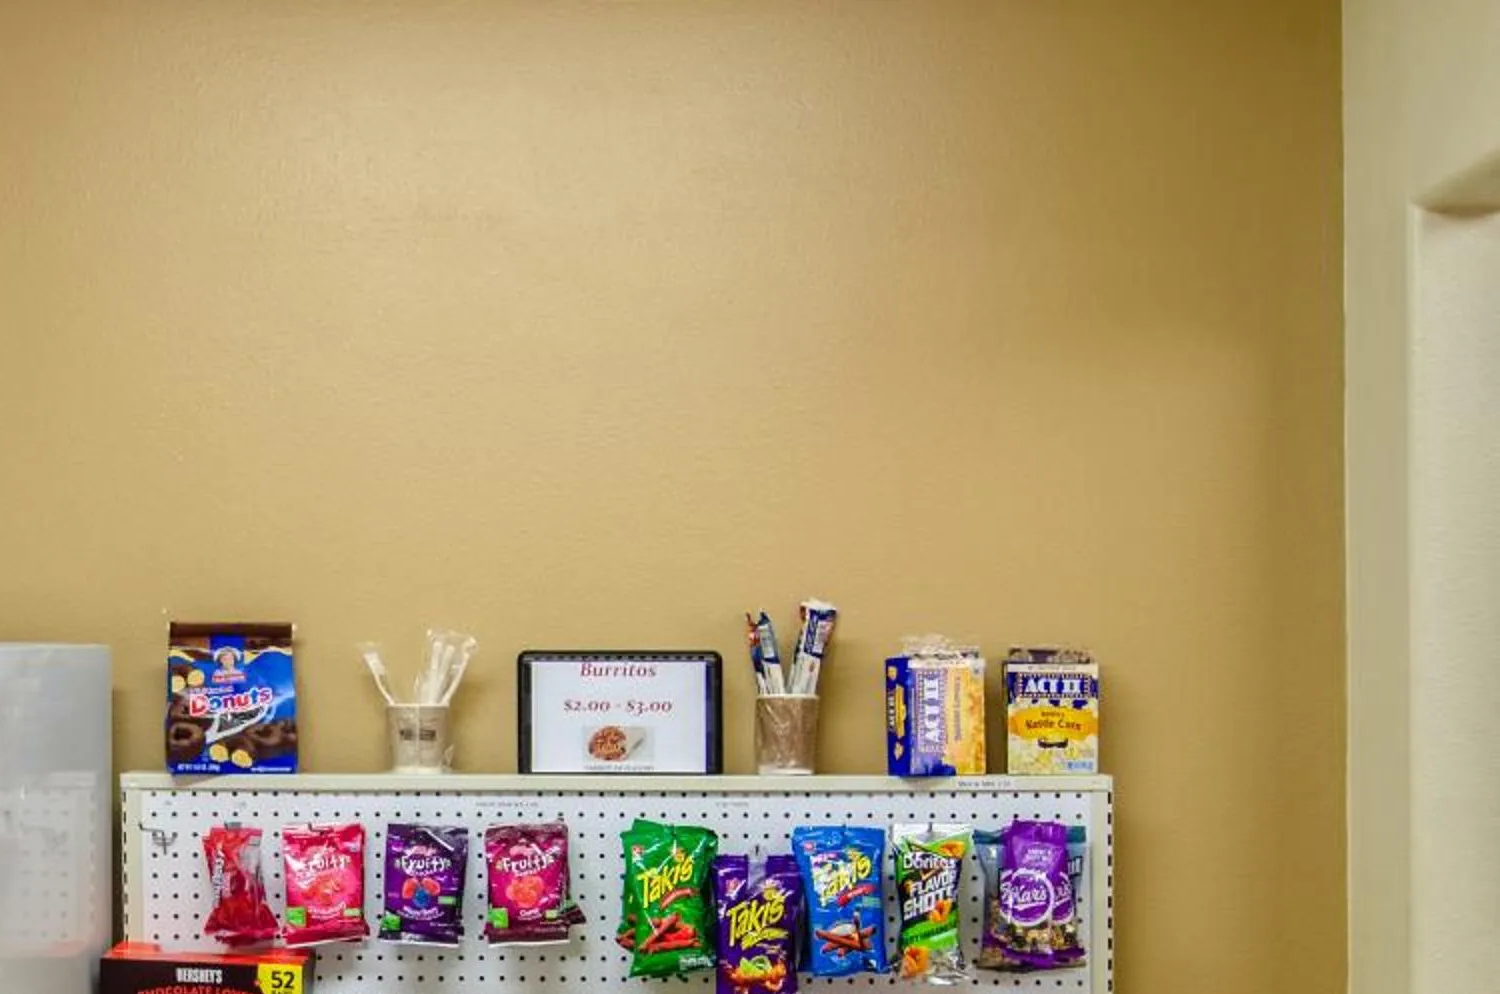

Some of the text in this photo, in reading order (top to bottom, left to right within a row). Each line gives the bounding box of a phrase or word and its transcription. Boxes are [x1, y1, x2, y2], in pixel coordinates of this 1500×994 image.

[580, 661, 656, 678] Burritos
[1025, 679, 1057, 694] ACT
[189, 687, 273, 717] Donuts
[563, 699, 611, 713] $2.00
[625, 699, 673, 717] $3.00
[401, 856, 446, 874] Fruity
[503, 854, 550, 873] Fruity
[902, 851, 957, 870] Doritos
[636, 858, 695, 909] Takis
[727, 890, 786, 947] Takis
[175, 967, 223, 984] HERSHEY'S
[271, 971, 296, 989] 52
